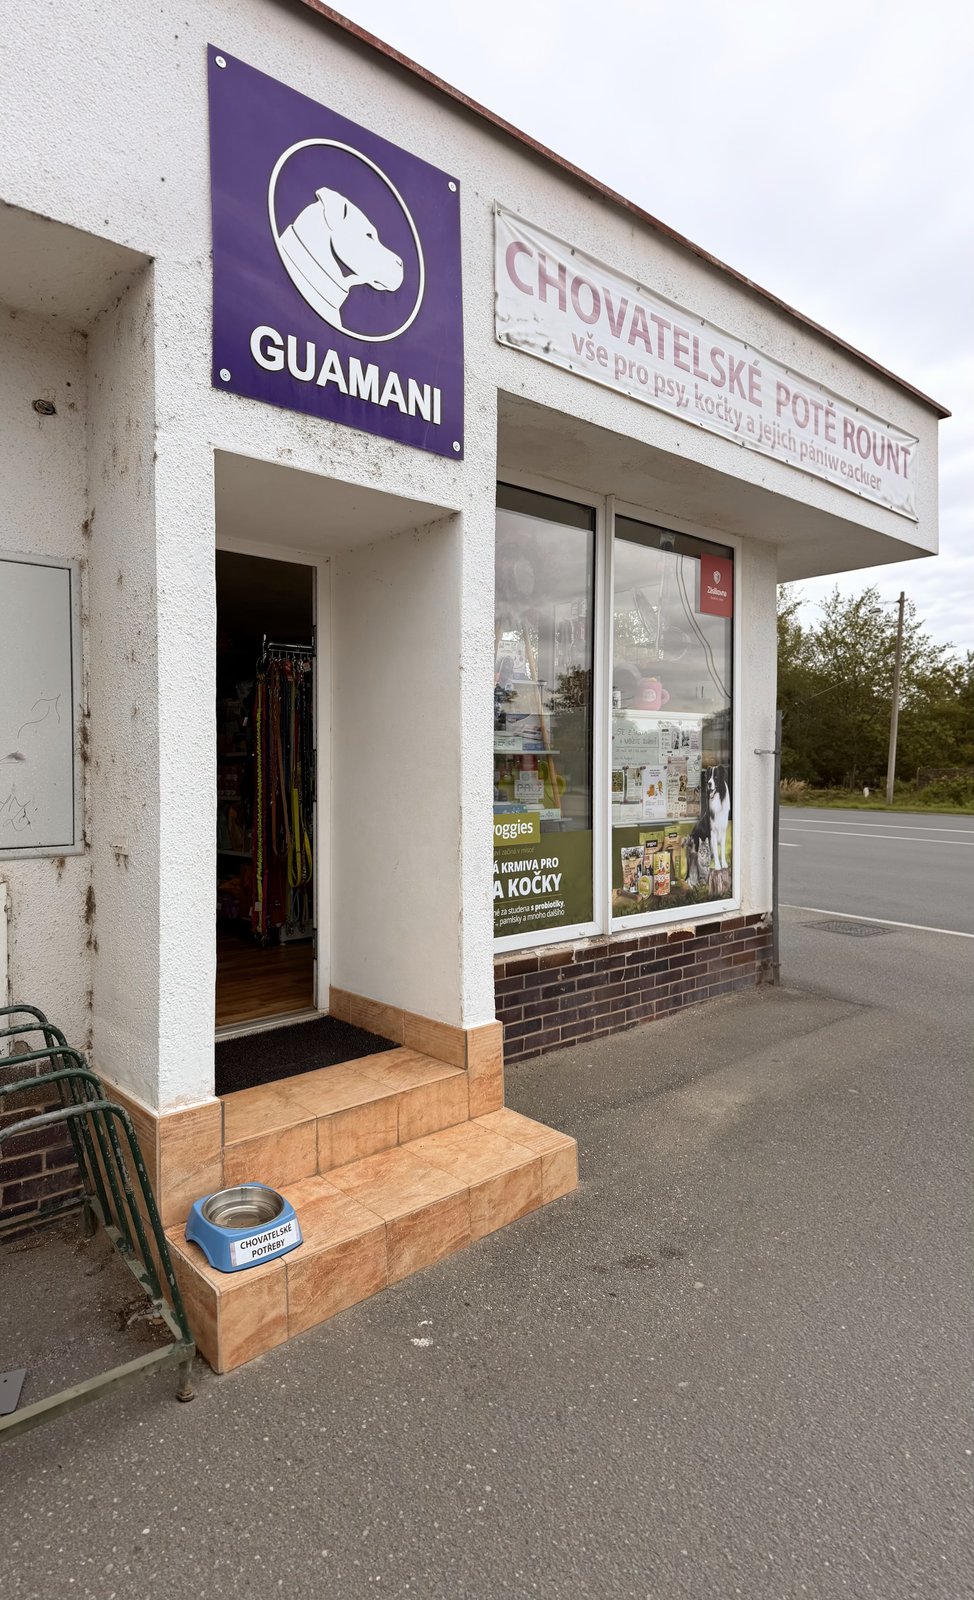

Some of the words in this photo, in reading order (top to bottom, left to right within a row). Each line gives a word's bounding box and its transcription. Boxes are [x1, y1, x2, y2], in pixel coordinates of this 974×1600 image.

[505, 241, 762, 408] CHOVATELSKÉ
[775, 381, 837, 445] POTĚ
[843, 415, 911, 479] ROUNT
[250, 325, 441, 425] GUAMANI
[572, 331, 609, 369] vše
[614, 353, 649, 384] pro
[654, 373, 690, 408] psy,
[694, 383, 743, 432] kočky
[746, 414, 755, 434] a
[757, 414, 797, 453] jejich
[501, 859, 539, 874] KRMIVA
[541, 857, 559, 870] PRO
[508, 870, 562, 898] KOČKY
[501, 908, 507, 916] za
[240, 1223, 292, 1250] CHOVATELSKÉ
[251, 1239, 285, 1258] POTŘEBY
